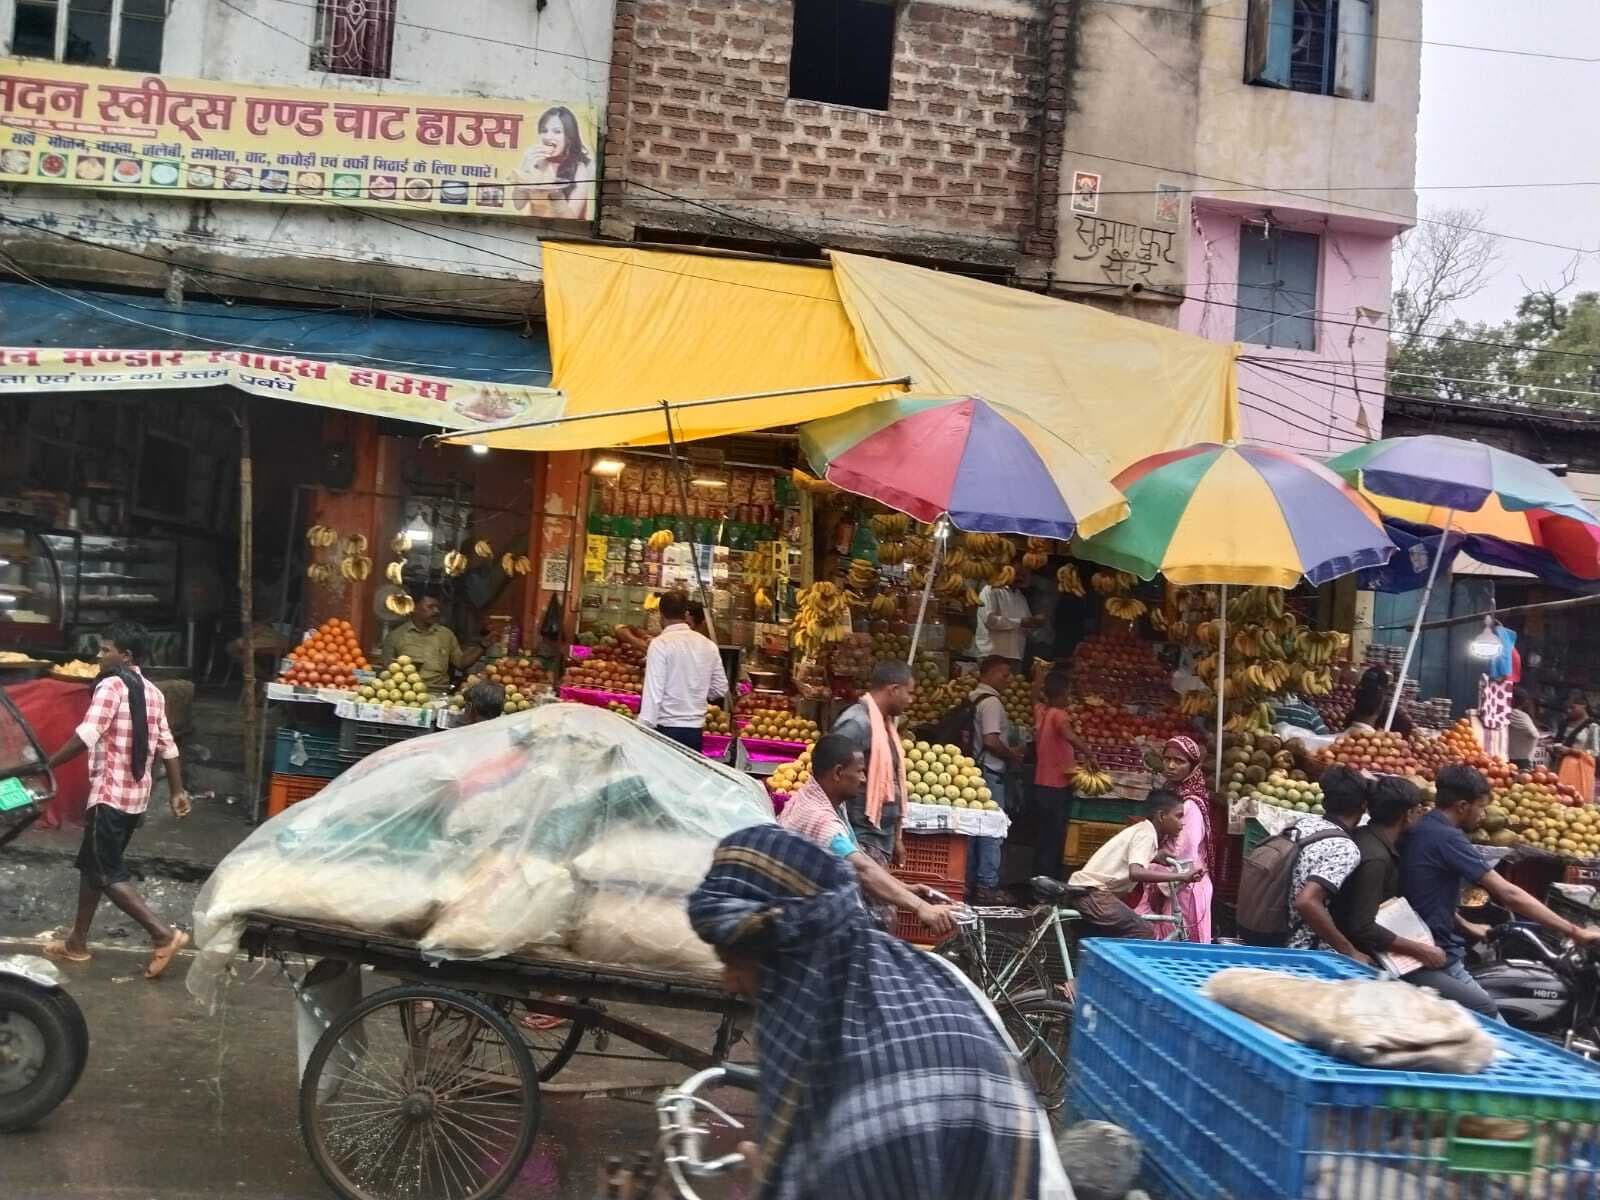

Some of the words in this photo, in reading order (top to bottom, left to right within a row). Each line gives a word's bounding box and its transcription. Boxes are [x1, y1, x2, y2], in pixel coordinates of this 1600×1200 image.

[98, 76, 237, 140] स्वीट्स
[245, 97, 328, 136] एण्ड
[334, 103, 409, 141] चाट
[416, 107, 523, 149] हाउस
[191, 147, 239, 164] समोसा,
[374, 155, 409, 173] मिठाई
[413, 159, 428, 173] के
[431, 159, 456, 175] लिए
[35, 372, 75, 384] एवं
[172, 368, 232, 381] उत्तम
[238, 373, 298, 392] प्रबंध
[350, 368, 454, 401] हाउस
